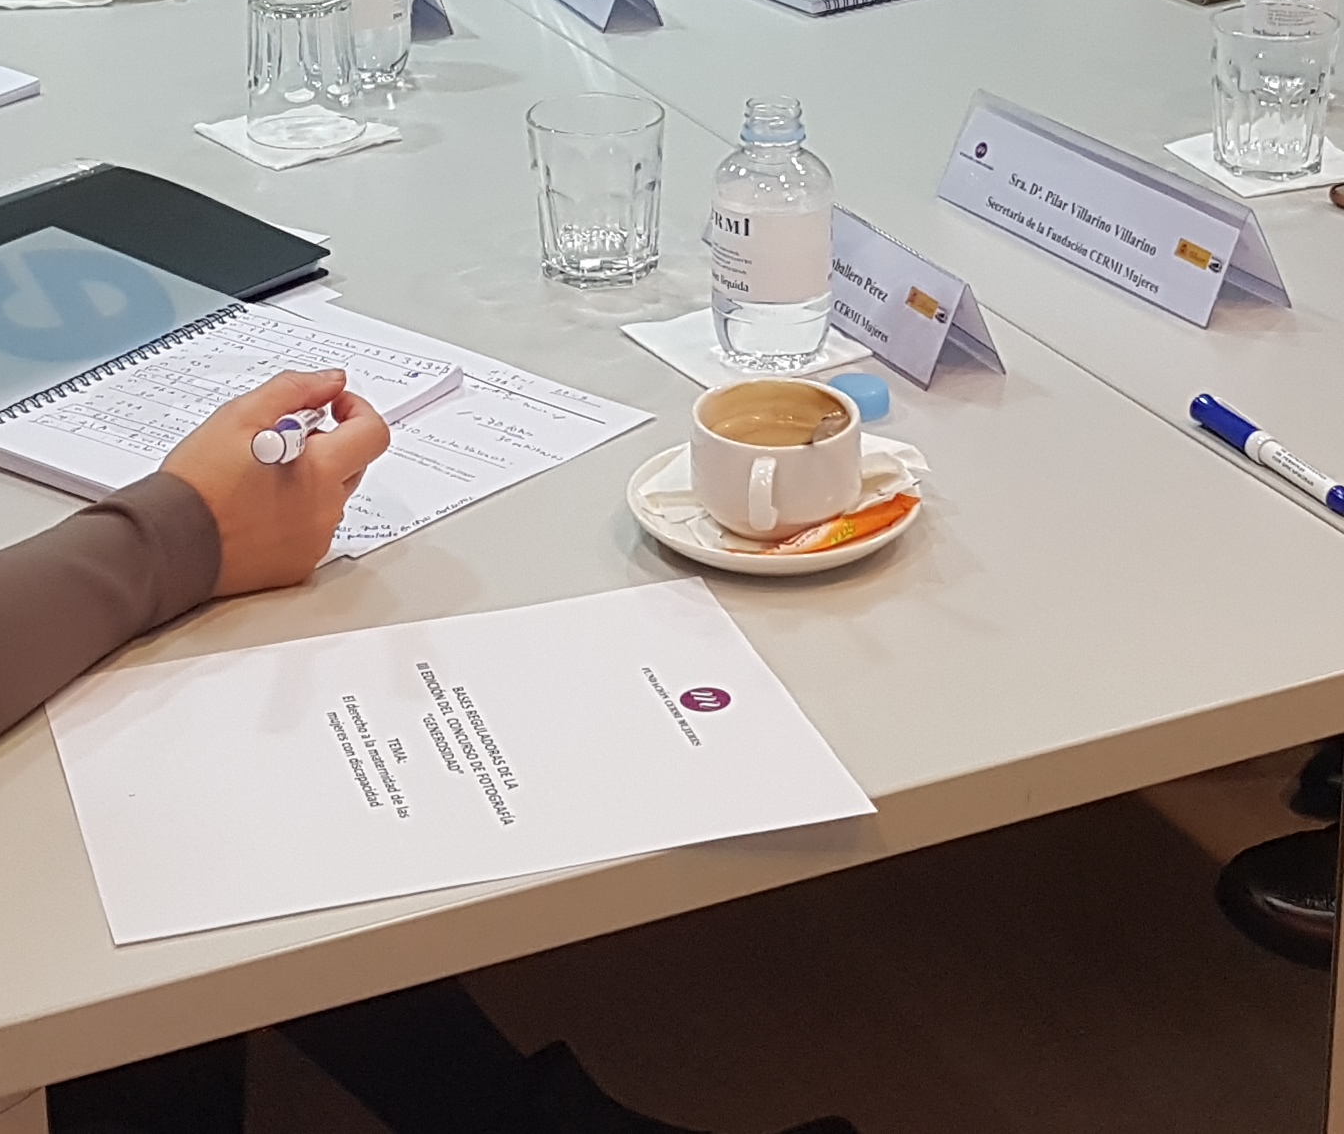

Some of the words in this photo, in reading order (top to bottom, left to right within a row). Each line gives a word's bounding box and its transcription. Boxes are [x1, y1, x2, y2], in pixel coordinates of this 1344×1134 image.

[1008, 172, 1028, 193] Sra.
[1044, 189, 1070, 213] Pilar
[1070, 201, 1112, 235] Villarino
[1114, 223, 1157, 257] Villarino
[985, 195, 1026, 226] Secretaria
[1025, 214, 1036, 231] de
[1036, 221, 1045, 236] la
[1088, 248, 1124, 276] CERMI
[1123, 265, 1160, 296] Mujeres
[863, 277, 889, 303] Pérez
[833, 299, 862, 325] CERMI
[862, 315, 889, 344] Mujeres
[341, 695, 356, 704] El
[420, 670, 447, 701] EDICIÓN
[452, 685, 474, 710] BASES
[345, 703, 369, 733] derecho
[437, 700, 454, 716] DEL
[363, 738, 377, 748] la
[387, 737, 408, 765] TEMA:
[446, 717, 479, 761] CONCURSO
[465, 709, 506, 767] REGULADORAS
[326, 711, 349, 742] mujeres
[341, 741, 355, 758] con
[348, 757, 385, 808] discapacidad
[367, 748, 402, 794] maternidad
[469, 760, 486, 774] DE
[497, 766, 513, 779] DE
[504, 778, 519, 791] LA
[390, 793, 405, 806] de
[396, 805, 410, 819] las
[476, 772, 517, 827] FOTOGRAFÍA
